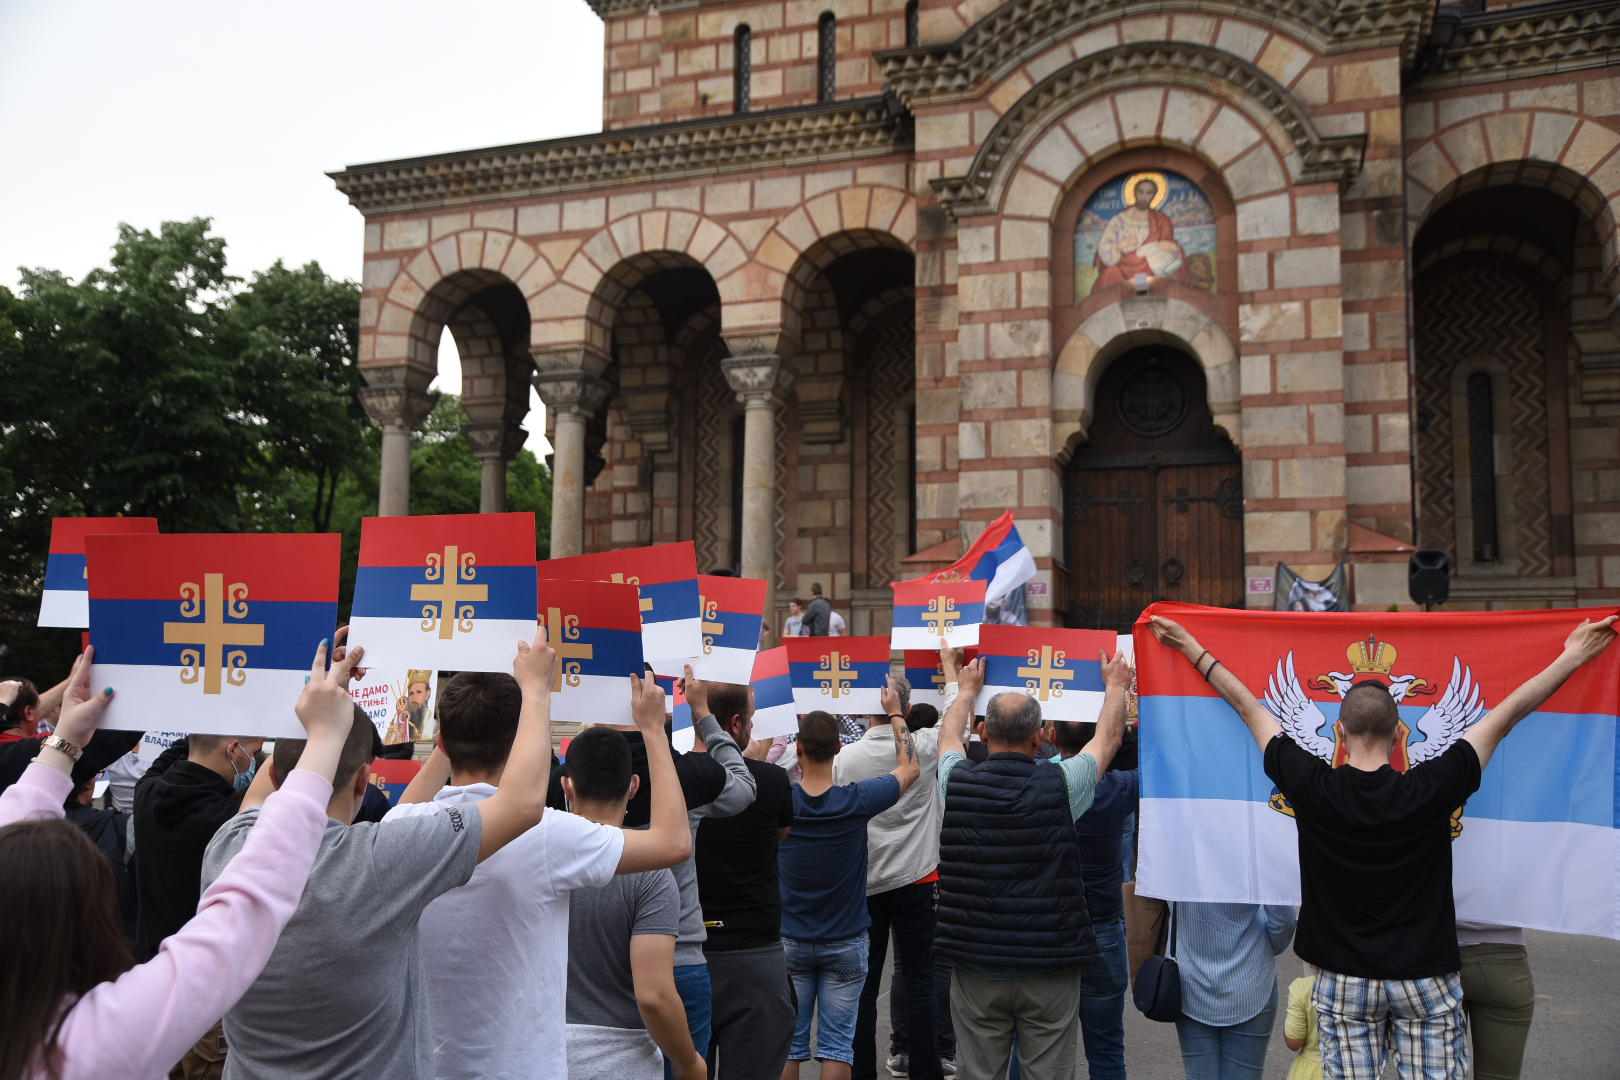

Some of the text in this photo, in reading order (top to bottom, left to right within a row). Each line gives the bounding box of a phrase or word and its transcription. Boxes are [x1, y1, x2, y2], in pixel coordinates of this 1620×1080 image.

[362, 684, 388, 698] ДАМО
[358, 697, 388, 707] ЕТИЊЕ!
[368, 708, 387, 719] АМО
